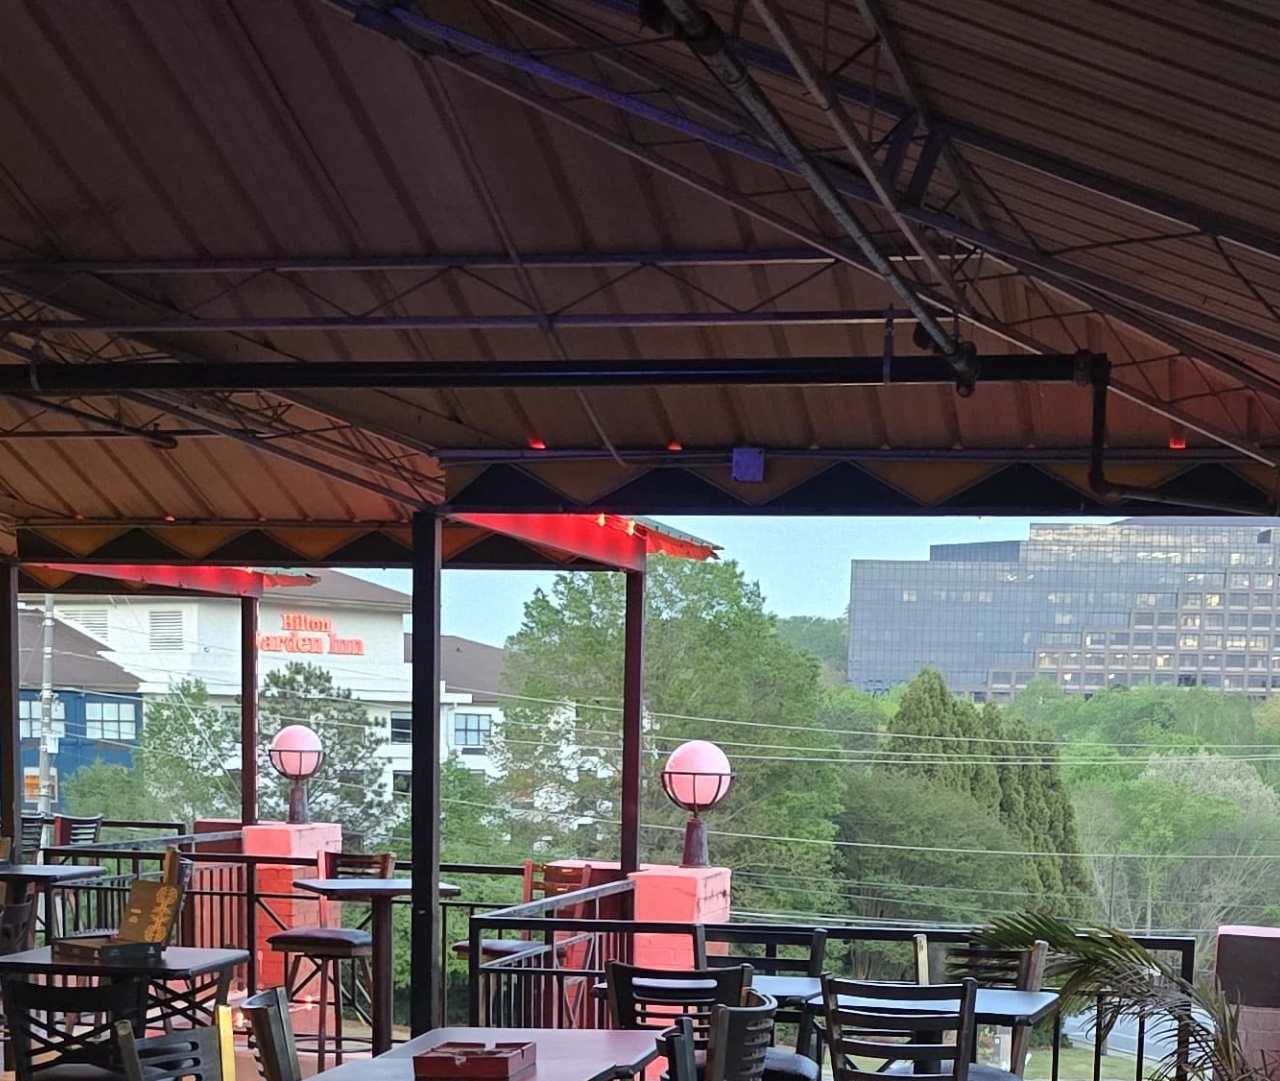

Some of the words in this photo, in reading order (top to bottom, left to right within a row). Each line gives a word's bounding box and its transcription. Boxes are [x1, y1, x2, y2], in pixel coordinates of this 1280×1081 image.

[282, 613, 330, 632] Hilton
[256, 632, 324, 655] arden
[328, 633, 364, 655] Inn
